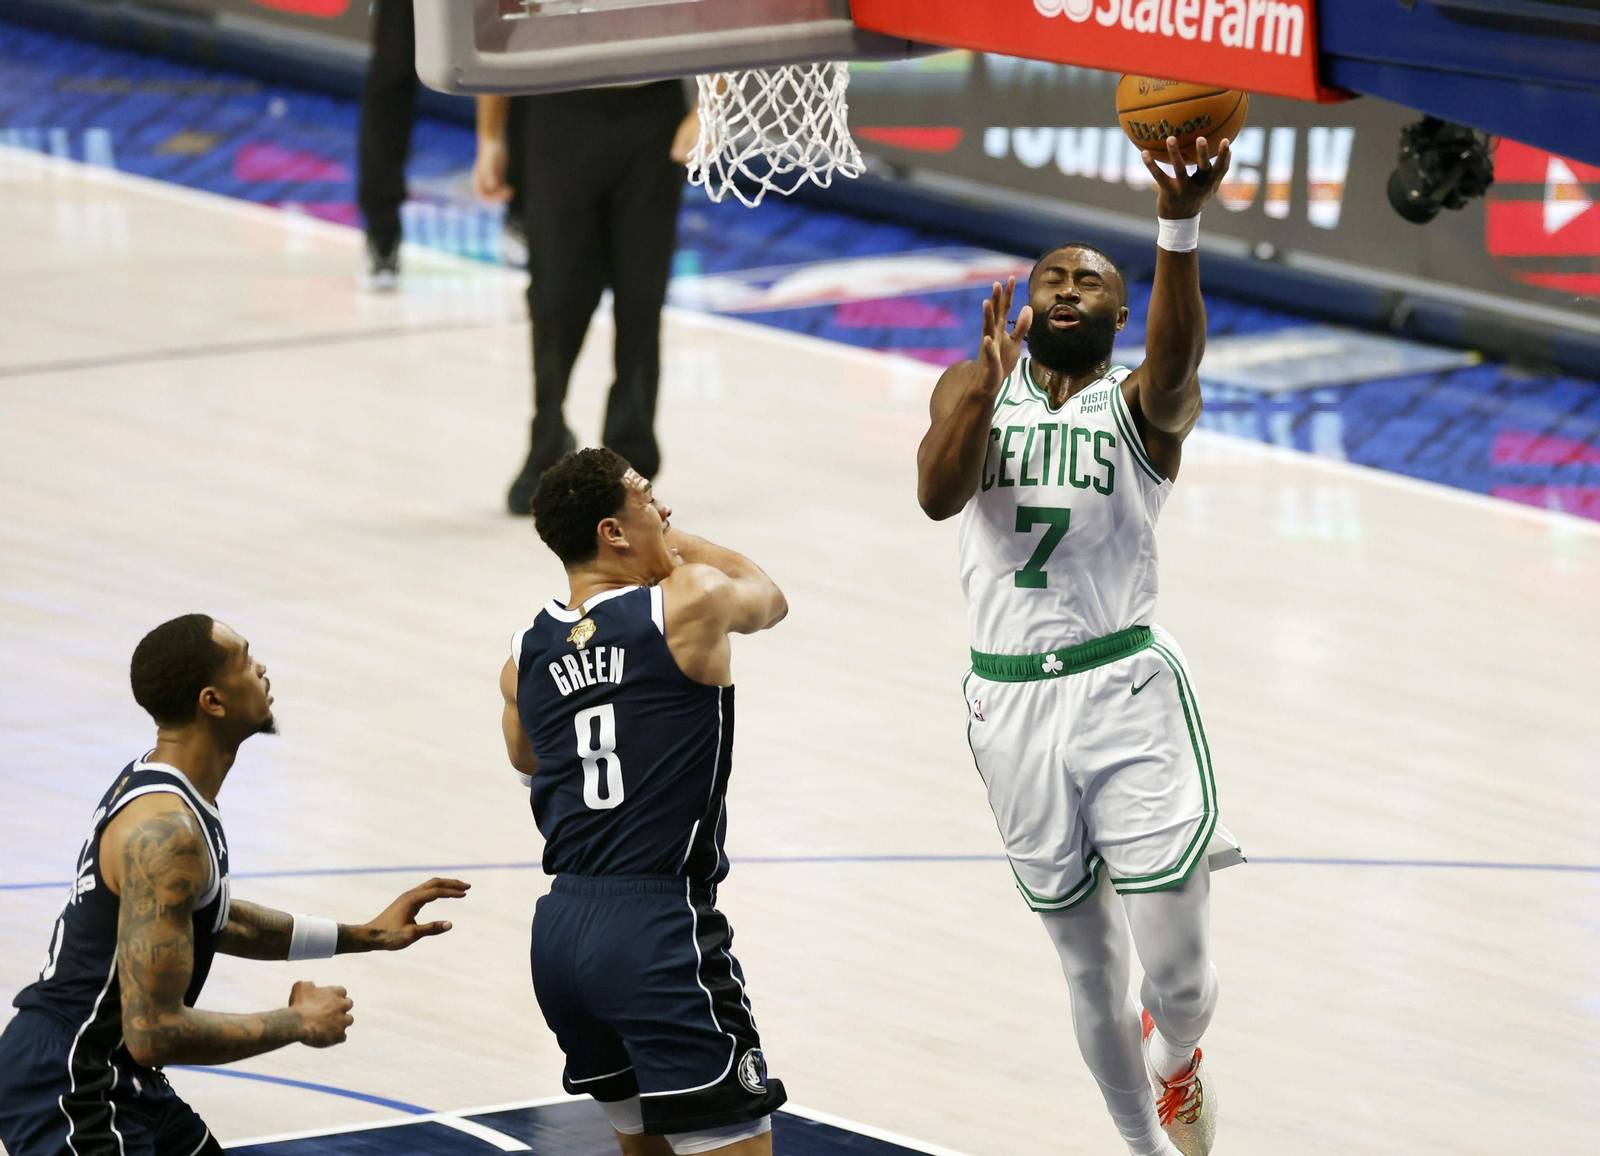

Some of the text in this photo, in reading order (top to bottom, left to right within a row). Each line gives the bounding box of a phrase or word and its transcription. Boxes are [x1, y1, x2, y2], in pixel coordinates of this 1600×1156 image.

[1128, 113, 1213, 142] Wilson
[1080, 401, 1108, 414] PRINT
[1081, 390, 1109, 405] VISTA
[981, 423, 1116, 496] CELTICS
[1014, 506, 1071, 589] 7
[549, 646, 625, 697] GREEN
[574, 703, 625, 810] 8
